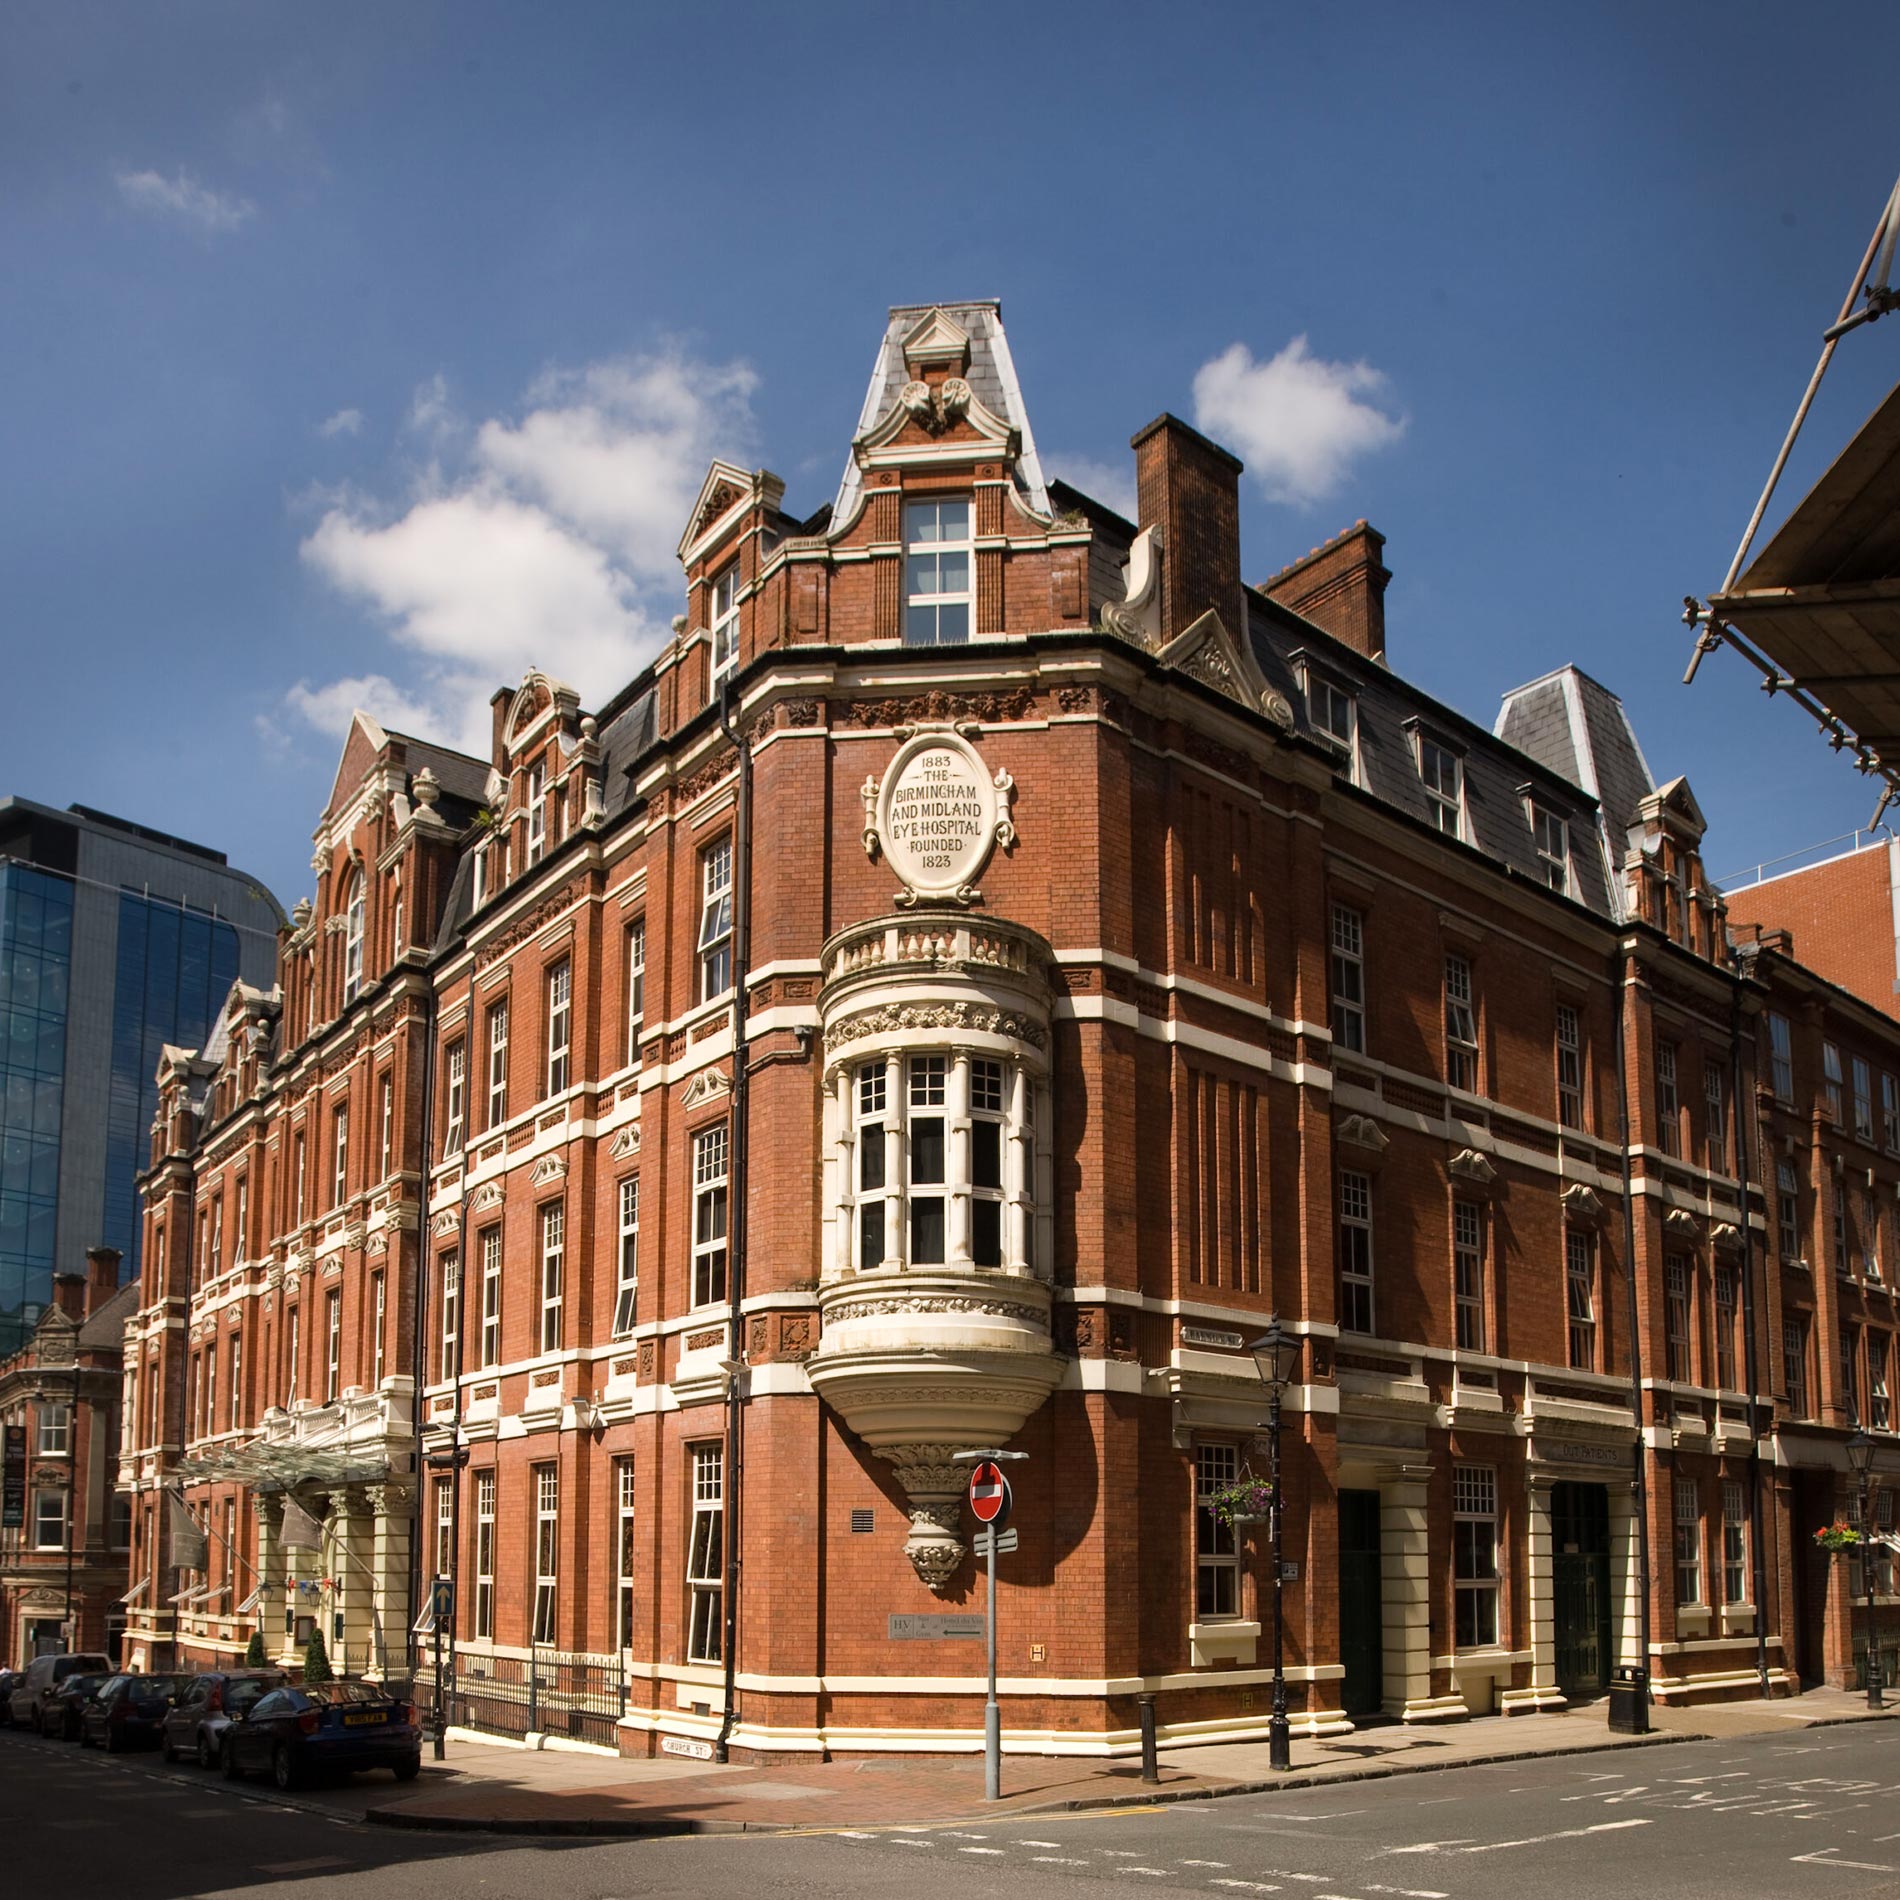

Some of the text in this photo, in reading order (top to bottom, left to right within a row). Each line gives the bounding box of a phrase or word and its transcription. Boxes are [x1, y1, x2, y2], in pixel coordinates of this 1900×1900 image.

[922, 756, 951, 768] 1883
[924, 770, 948, 782] THE
[896, 785, 977, 803] BIRMINGHAM
[891, 802, 982, 821] AND MIDLAND
[893, 819, 982, 839] EYE HOSPITAL
[910, 838, 963, 853] FOUNDED
[922, 855, 951, 868] 1823
[1563, 1443, 1618, 1460] OUT PATIENTS
[1031, 1646, 1043, 1660] H
